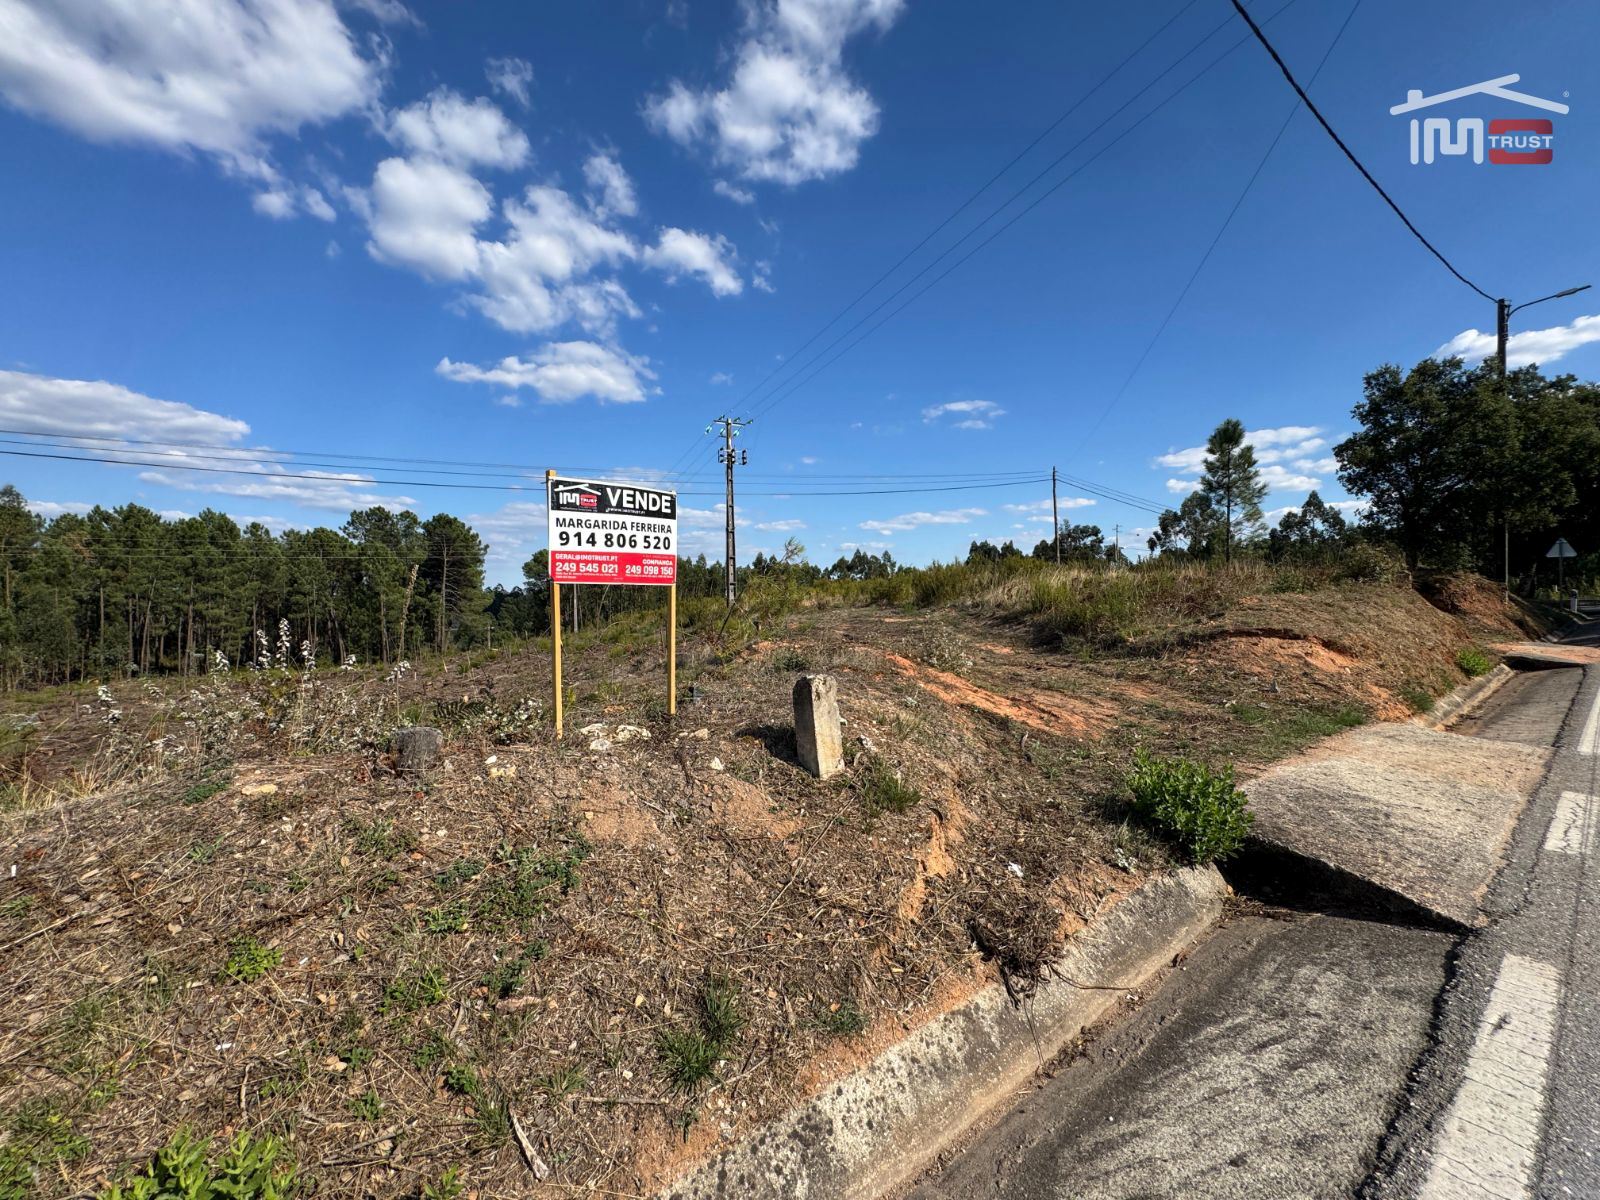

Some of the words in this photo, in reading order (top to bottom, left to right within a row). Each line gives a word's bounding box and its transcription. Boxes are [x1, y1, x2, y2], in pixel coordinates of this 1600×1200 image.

[606, 487, 671, 513] VENDE
[556, 517, 627, 530] MARGARIDA
[631, 521, 672, 533] FERREIRA
[559, 531, 597, 546] 914
[604, 533, 637, 548] 806
[643, 535, 670, 550] 520
[556, 554, 617, 562] GERAL@IMOTRUST.PT
[556, 562, 576, 572] 249
[579, 562, 599, 573] 545
[602, 563, 618, 573] 021
[625, 564, 641, 574] 249
[643, 565, 659, 575] 098
[660, 566, 673, 575] 150
